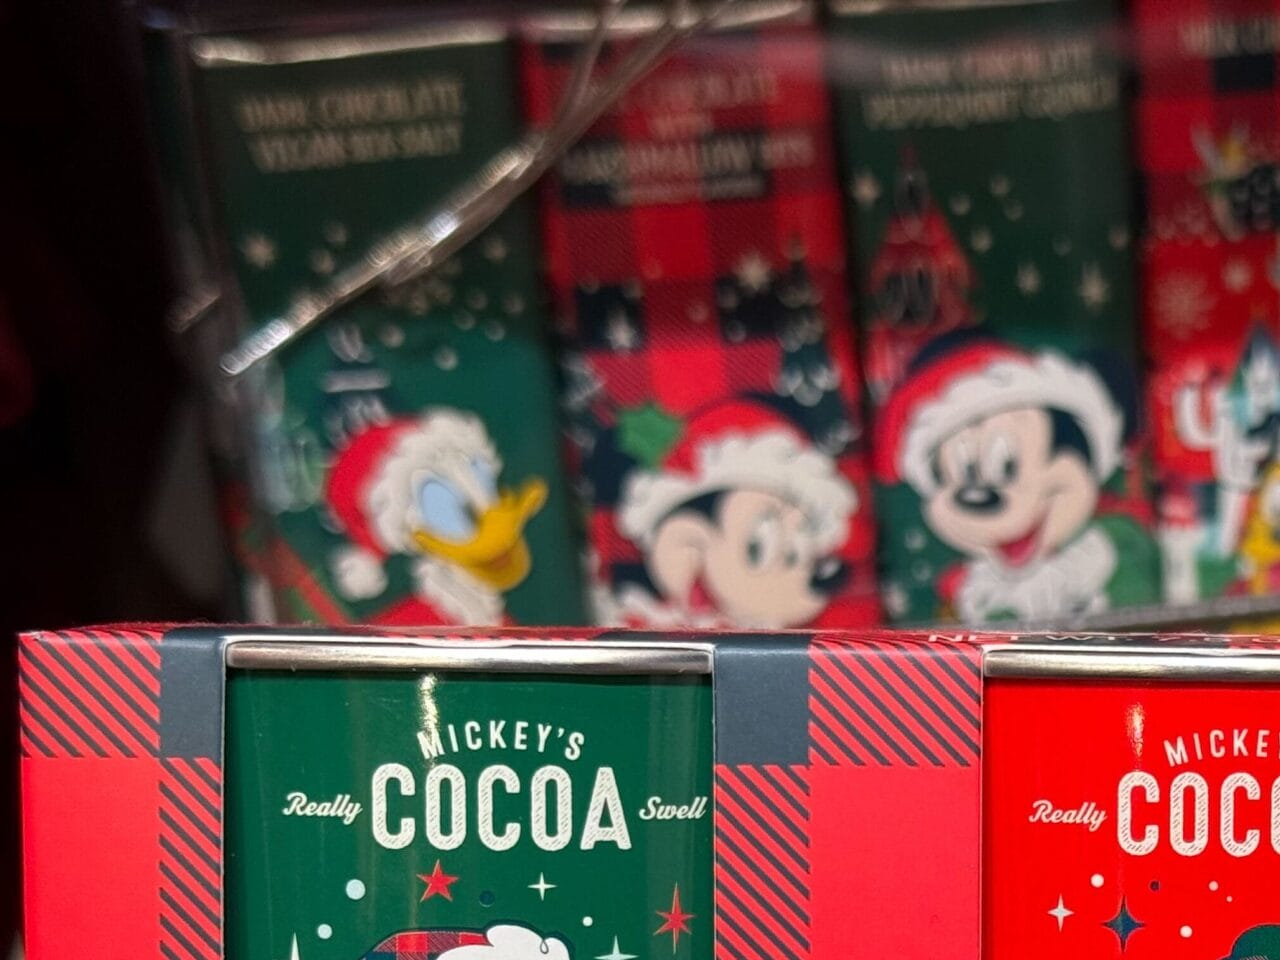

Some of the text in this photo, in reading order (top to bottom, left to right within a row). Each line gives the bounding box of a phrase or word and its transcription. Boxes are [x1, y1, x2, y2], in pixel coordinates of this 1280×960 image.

[417, 720, 585, 760] MICKEY'S
[283, 762, 707, 851] Really COCOA Swell
[1029, 800, 1107, 831] Really
